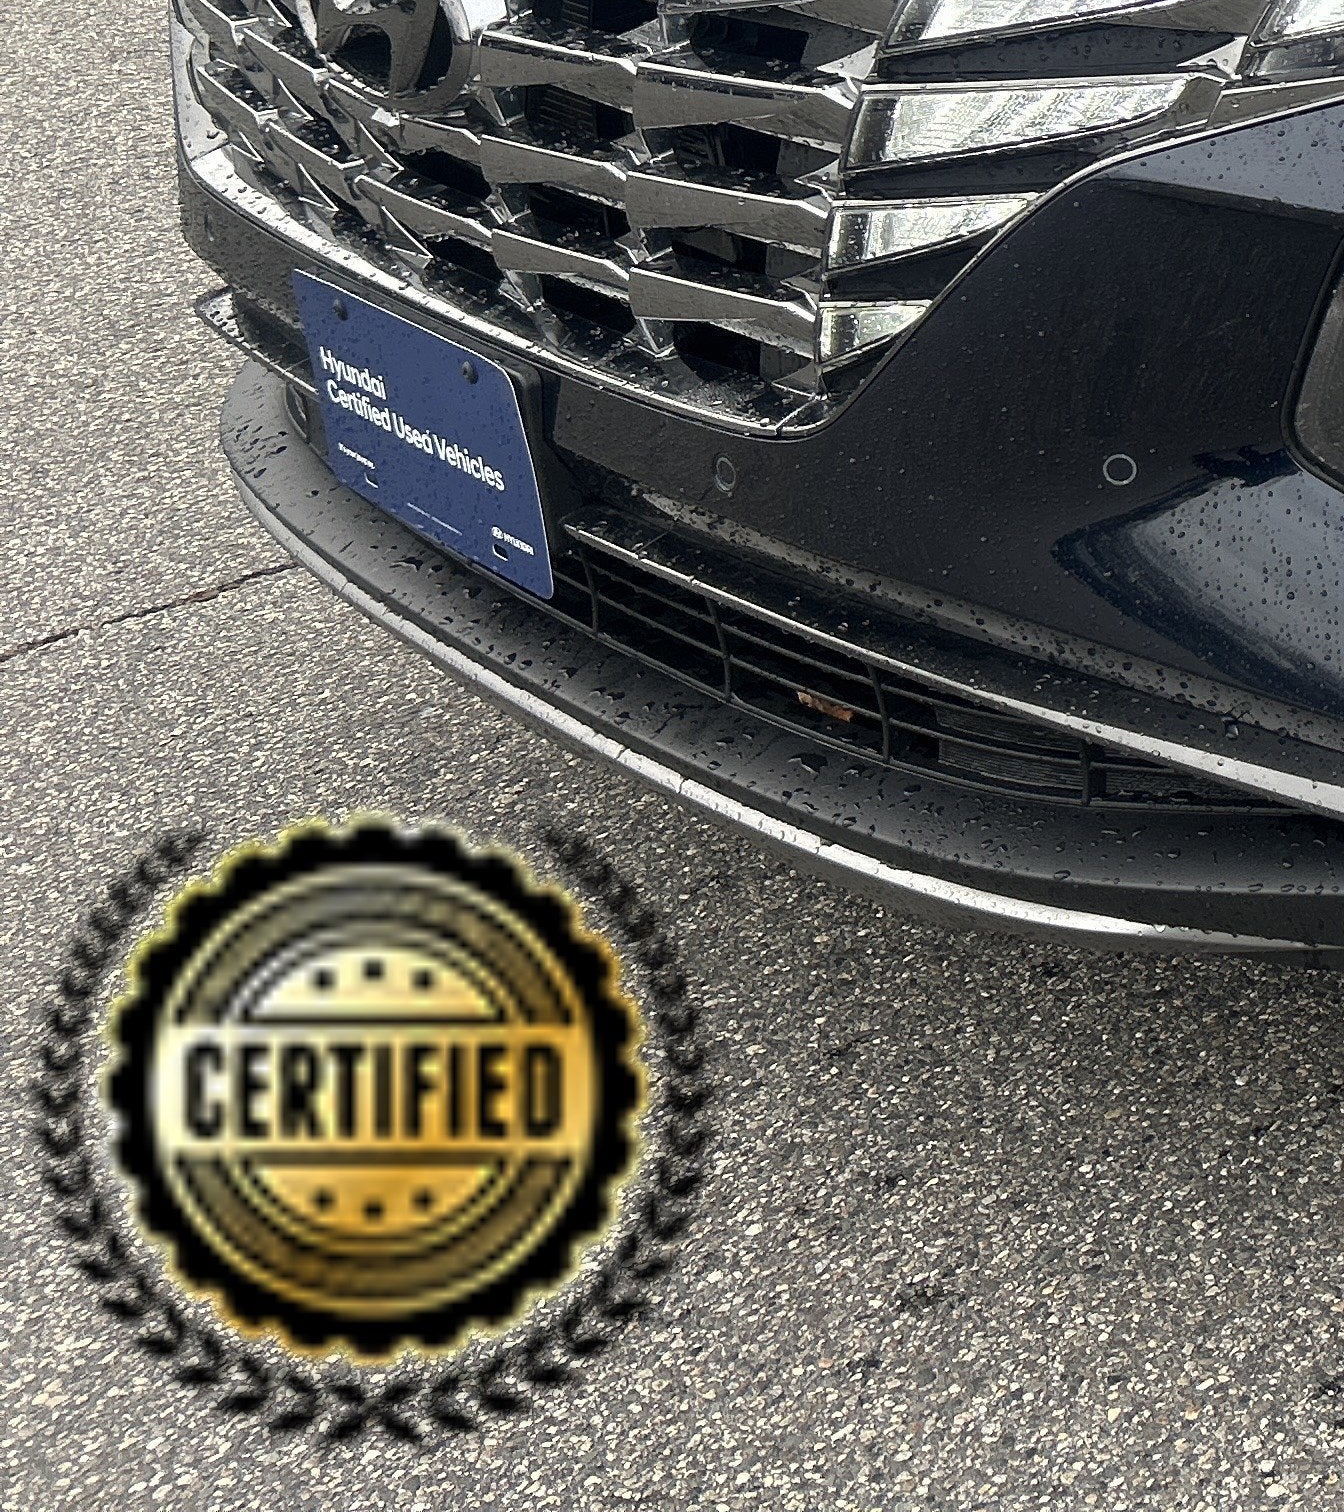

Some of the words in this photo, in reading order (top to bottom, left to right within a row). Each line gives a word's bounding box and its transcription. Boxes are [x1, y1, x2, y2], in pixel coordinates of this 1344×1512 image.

[319, 345, 388, 401] Hyundai
[326, 379, 392, 433] Certified
[391, 412, 434, 456] Used
[432, 435, 506, 492] Vehicles
